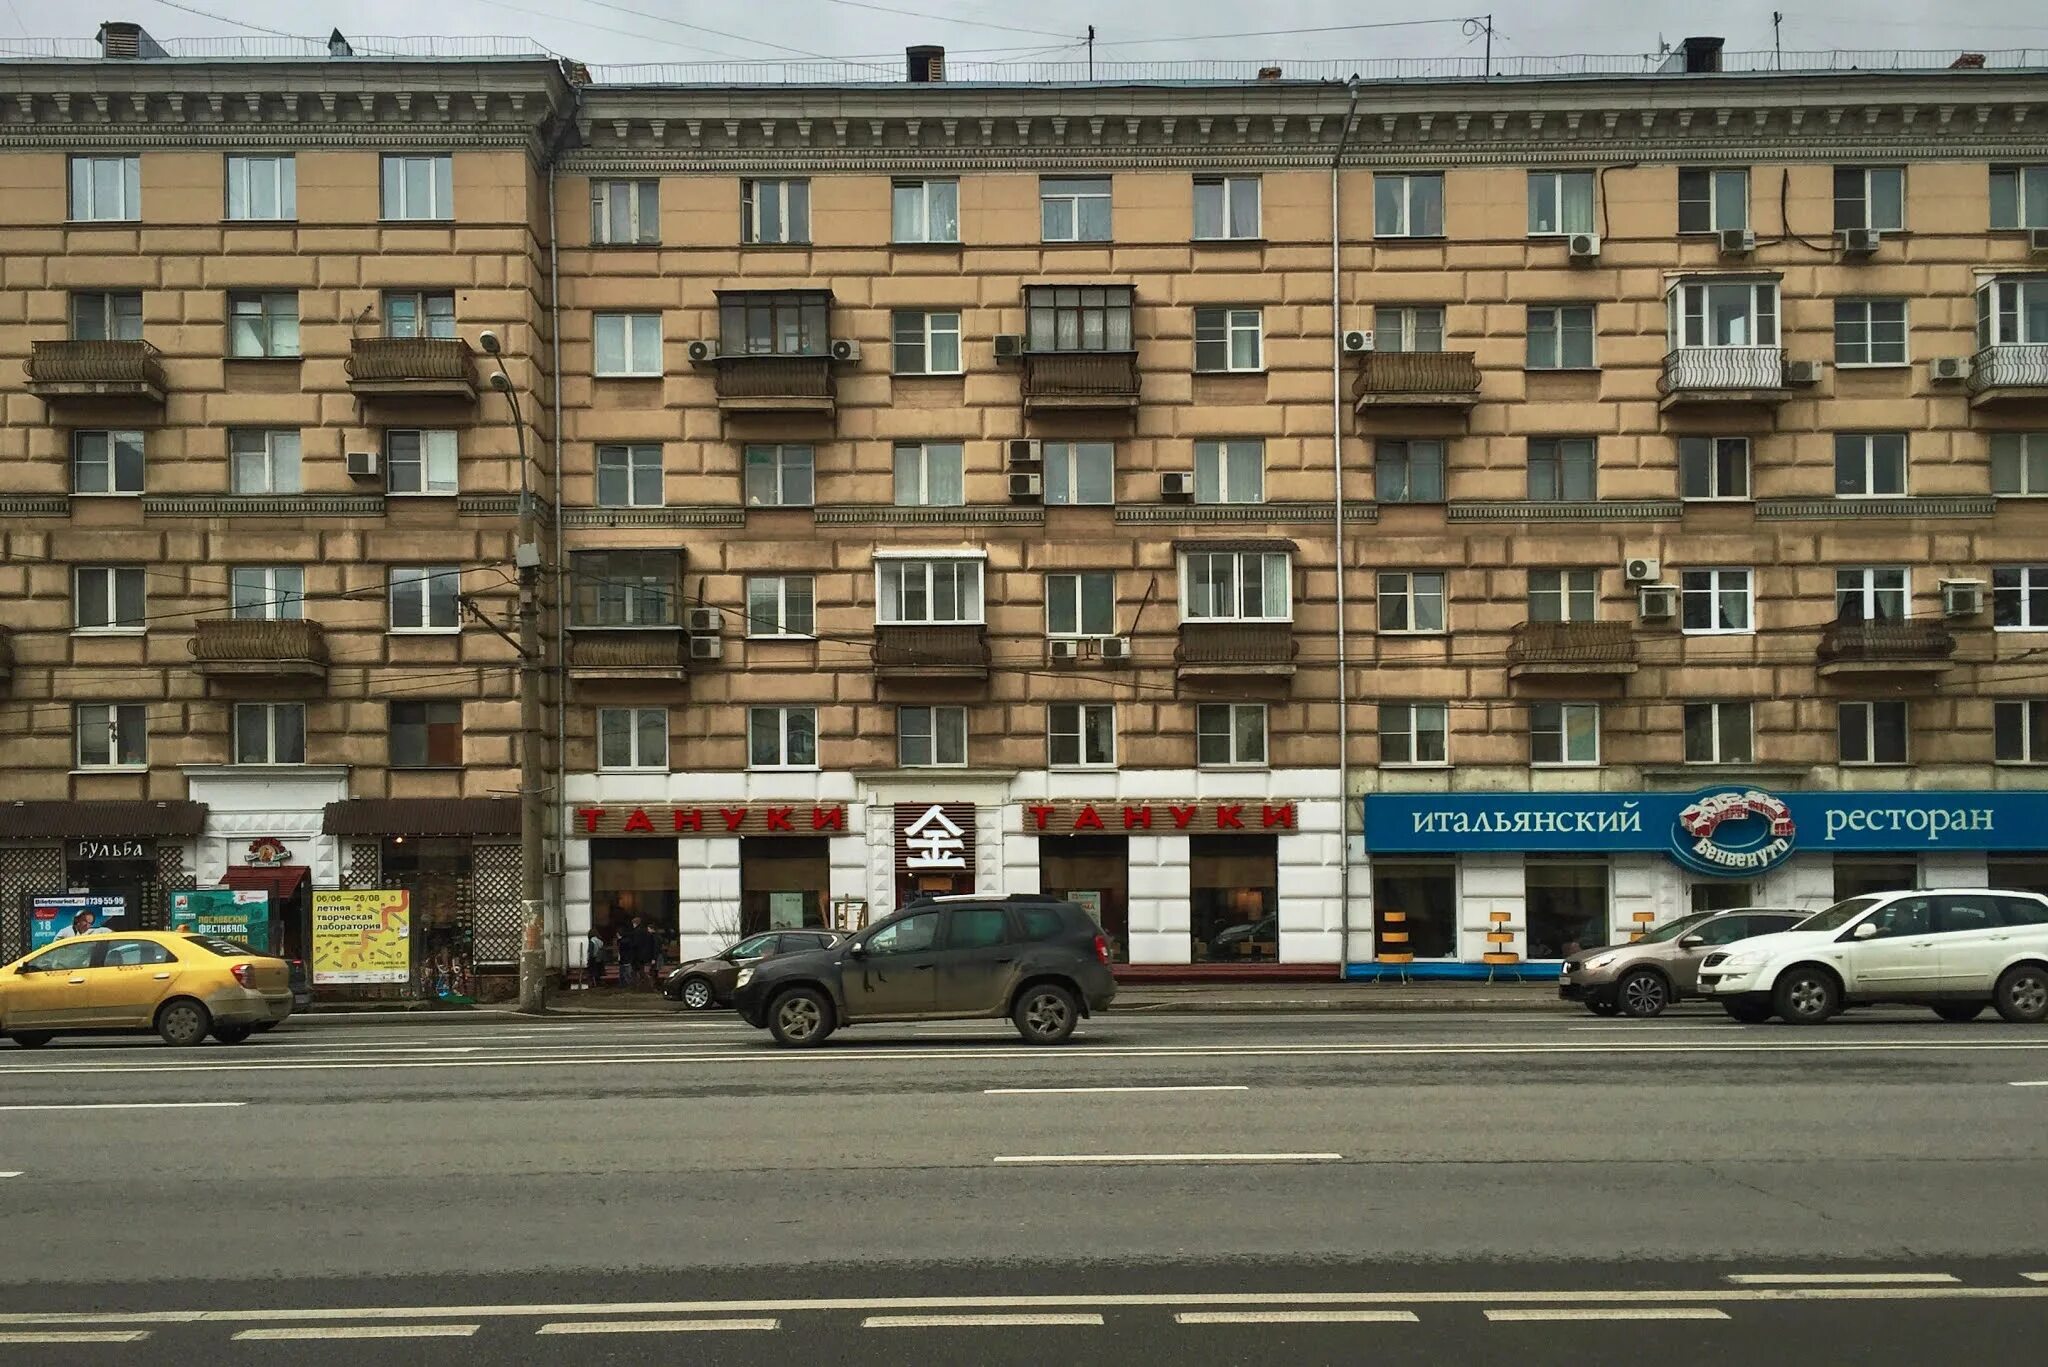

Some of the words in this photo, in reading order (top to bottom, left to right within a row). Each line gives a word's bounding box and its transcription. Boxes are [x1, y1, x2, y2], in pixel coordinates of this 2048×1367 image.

[577, 807, 843, 833] ТАНУКИ
[1028, 805, 1294, 830] ТАНУКИ
[1412, 801, 1643, 833] итальянский
[1824, 808, 1995, 841] ресторан
[904, 805, 966, 869] 金
[1692, 837, 1789, 868] Бенвенуто
[38, 921, 52, 931] 18
[316, 922, 381, 931] лаборатория
[317, 914, 373, 922] творческая
